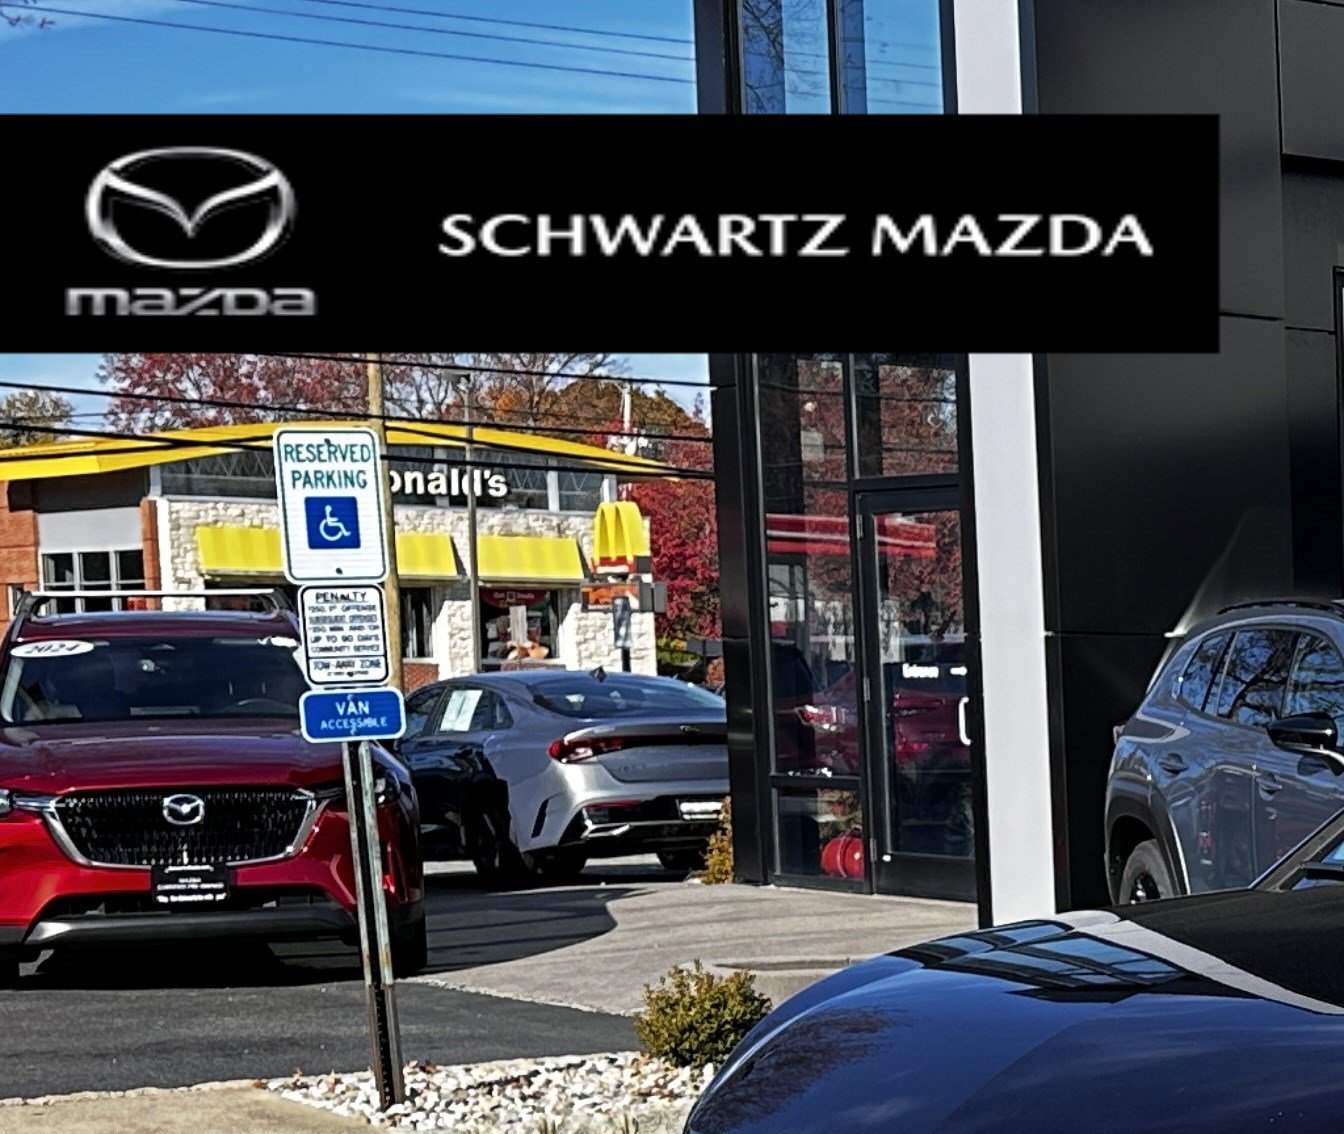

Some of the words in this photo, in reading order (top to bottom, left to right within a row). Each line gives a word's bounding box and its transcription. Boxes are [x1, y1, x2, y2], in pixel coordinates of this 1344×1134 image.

[283, 443, 371, 463] RESERVED
[291, 469, 368, 489] PARKING
[315, 591, 367, 603] PENALTY
[335, 700, 370, 716] VAN
[320, 716, 388, 730] ACCESSIBLE
